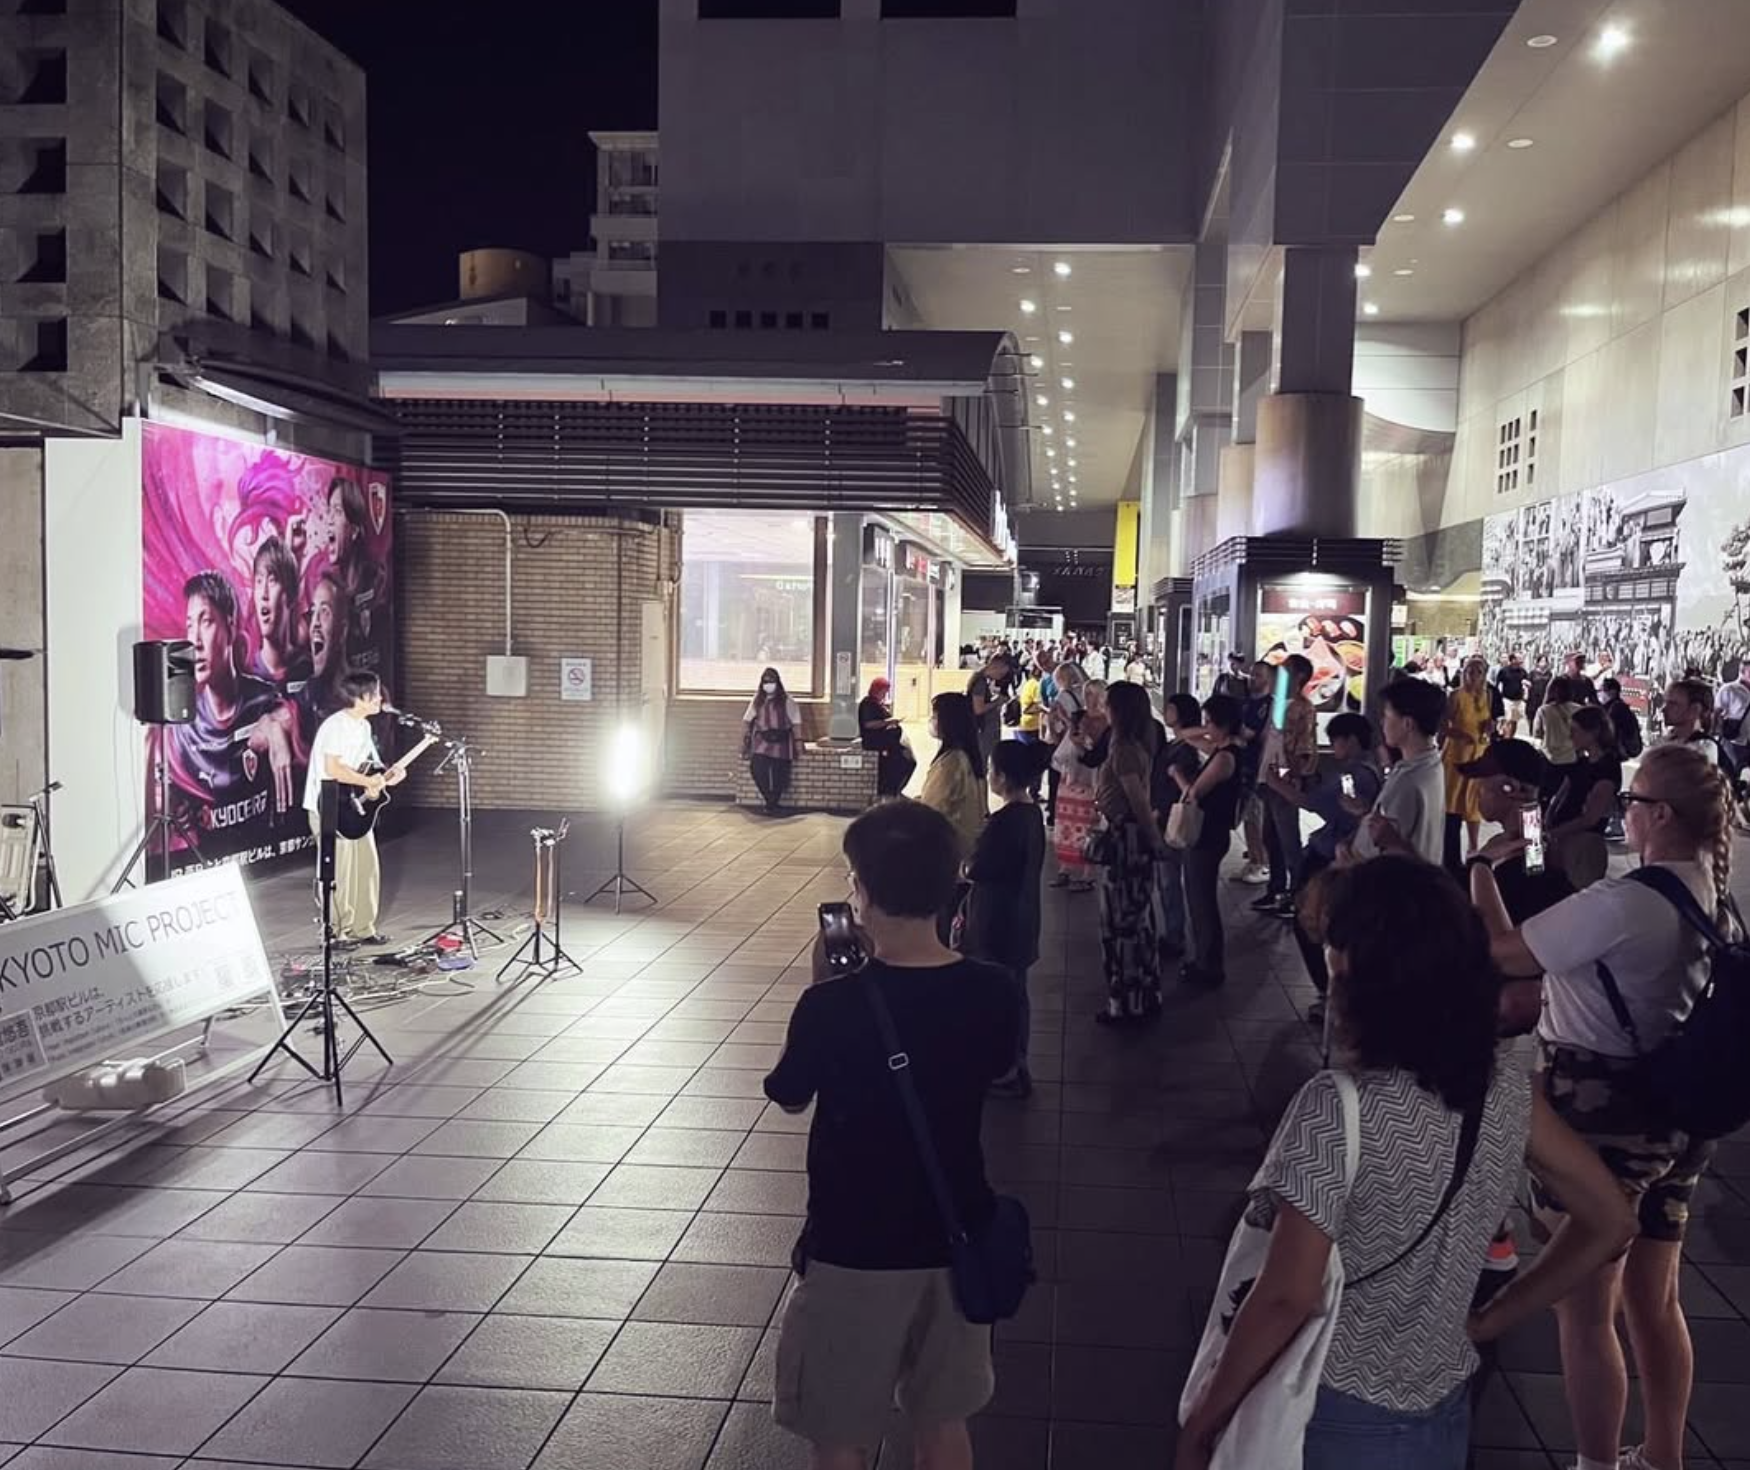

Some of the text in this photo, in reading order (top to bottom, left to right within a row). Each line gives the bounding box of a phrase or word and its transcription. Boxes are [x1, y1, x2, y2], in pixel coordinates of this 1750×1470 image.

[0, 890, 243, 992] KYOTO MIC PROJECT
